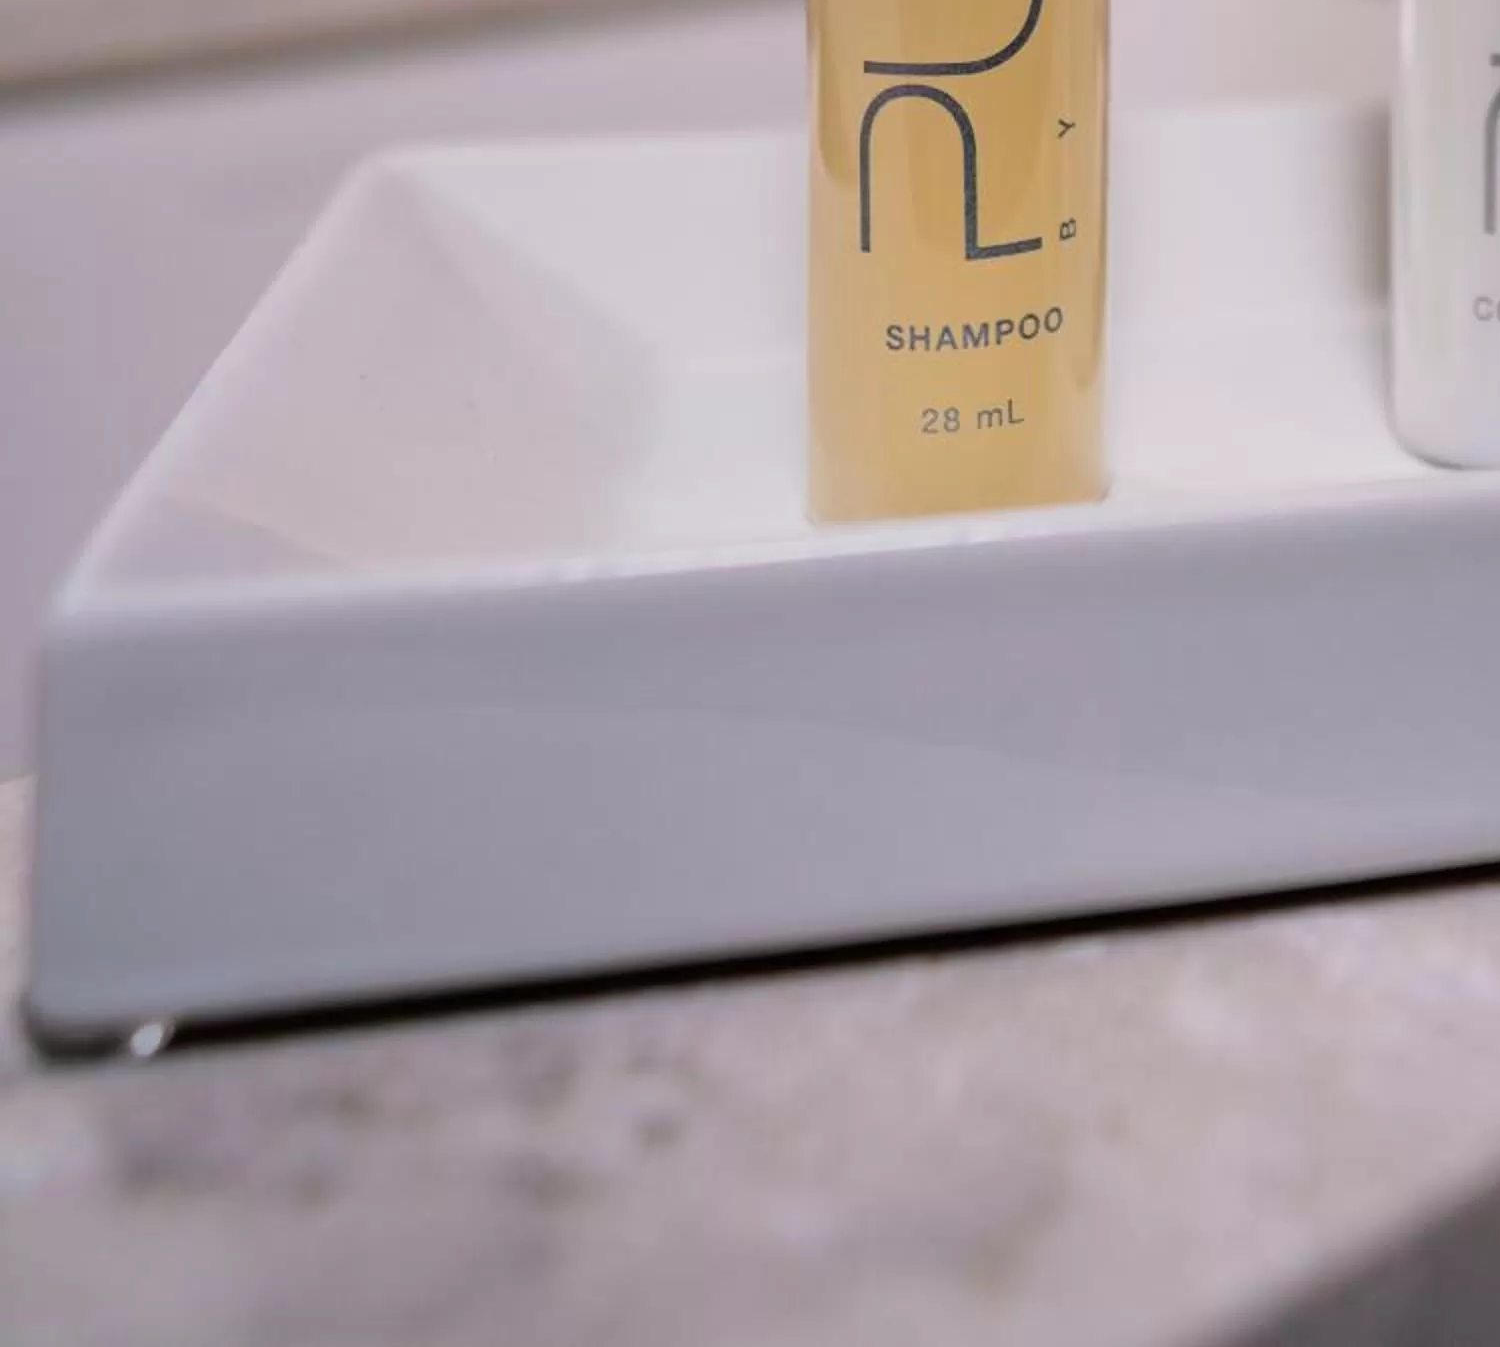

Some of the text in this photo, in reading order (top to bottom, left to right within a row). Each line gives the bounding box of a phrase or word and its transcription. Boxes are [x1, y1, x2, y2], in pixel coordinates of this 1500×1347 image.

[1057, 118, 1078, 241] BY
[886, 306, 1063, 351] SHAMPOO
[921, 398, 1025, 434] 28 mL
